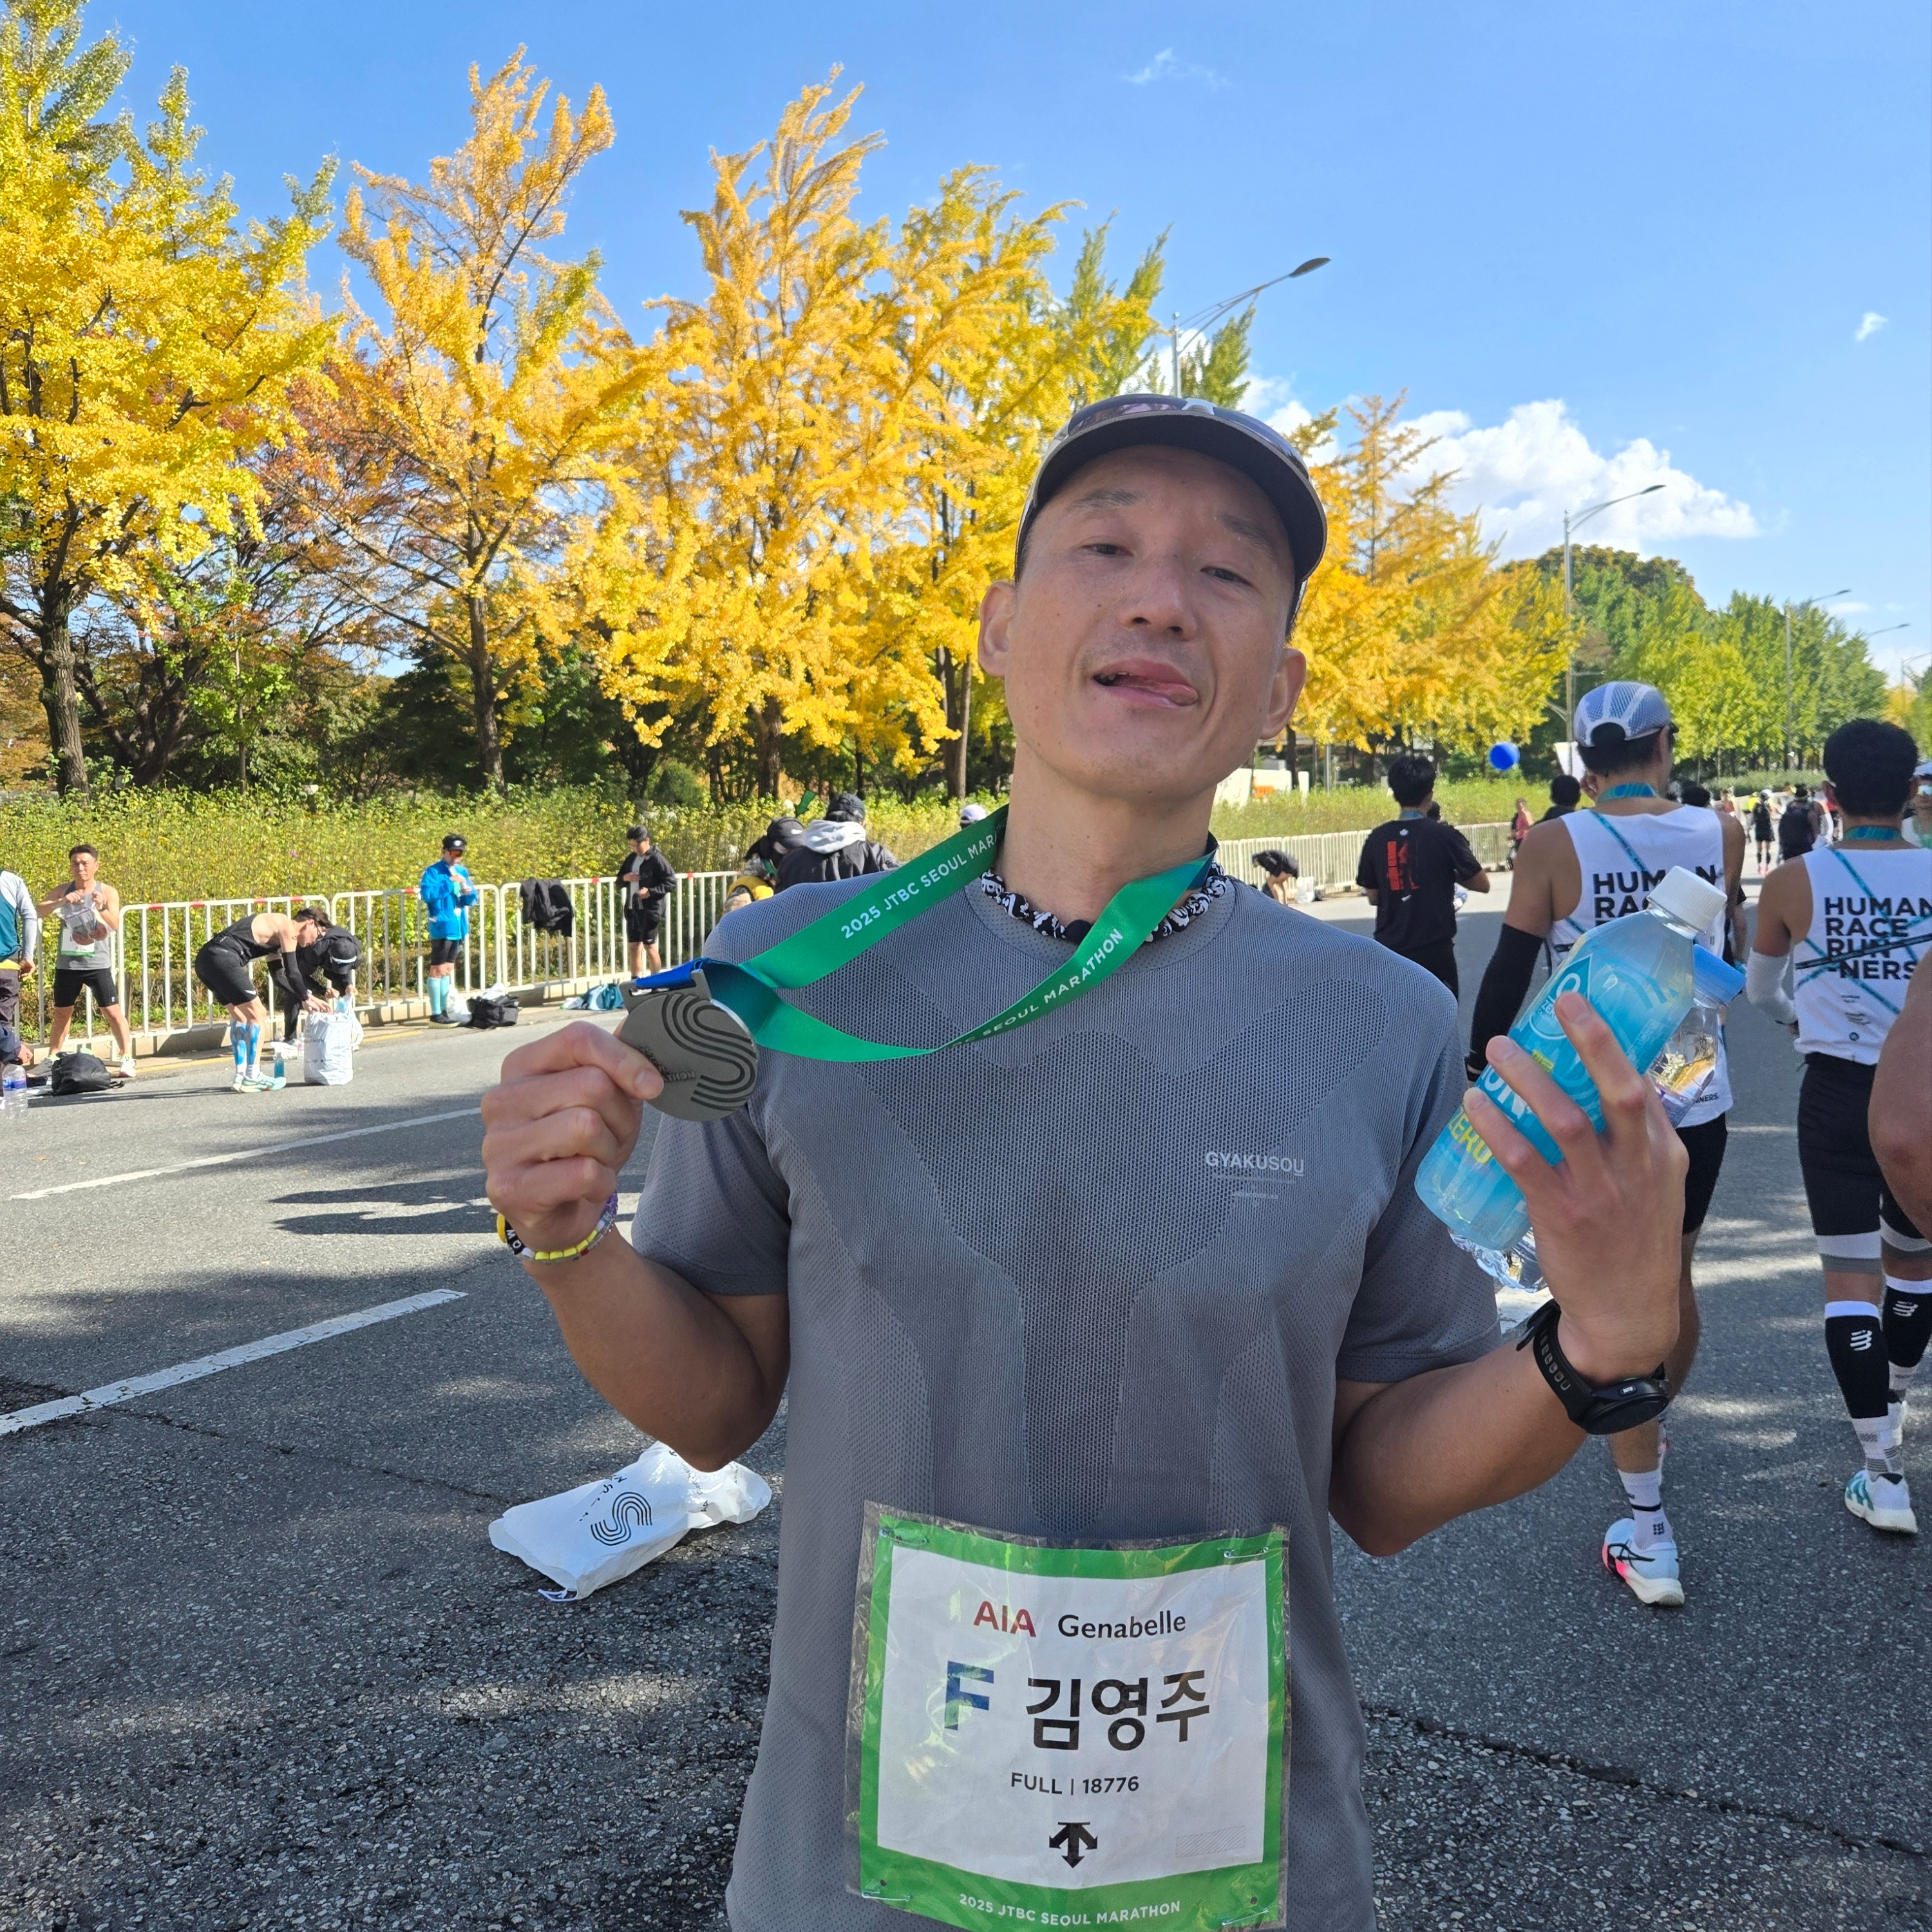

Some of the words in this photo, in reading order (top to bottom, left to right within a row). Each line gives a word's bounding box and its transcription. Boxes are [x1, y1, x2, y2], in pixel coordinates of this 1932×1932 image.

[841, 905, 881, 938] 2025
[884, 882, 920, 911] JTBC
[920, 854, 967, 887] SEOUL
[1593, 864, 1717, 895] HUMN
[1825, 918, 1909, 937] RACE
[983, 1005, 1039, 1036] SEOUL
[1044, 928, 1123, 1004] MARATHON
[1206, 1151, 1304, 1176] GYAKUSOU
[974, 1600, 1036, 1637] AIA
[1058, 1610, 1186, 1638] Genabelle
[944, 1660, 994, 1730] F
[1026, 1670, 1209, 1750] 김영주
[1011, 1772, 1062, 1794] FULL
[1083, 1776, 1139, 1794] 18776
[960, 1893, 993, 1913] 2025
[998, 1904, 1036, 1921] JTBC
[1041, 1912, 1091, 1926] SEOUL
[1097, 1900, 1180, 1924] MARATHON
